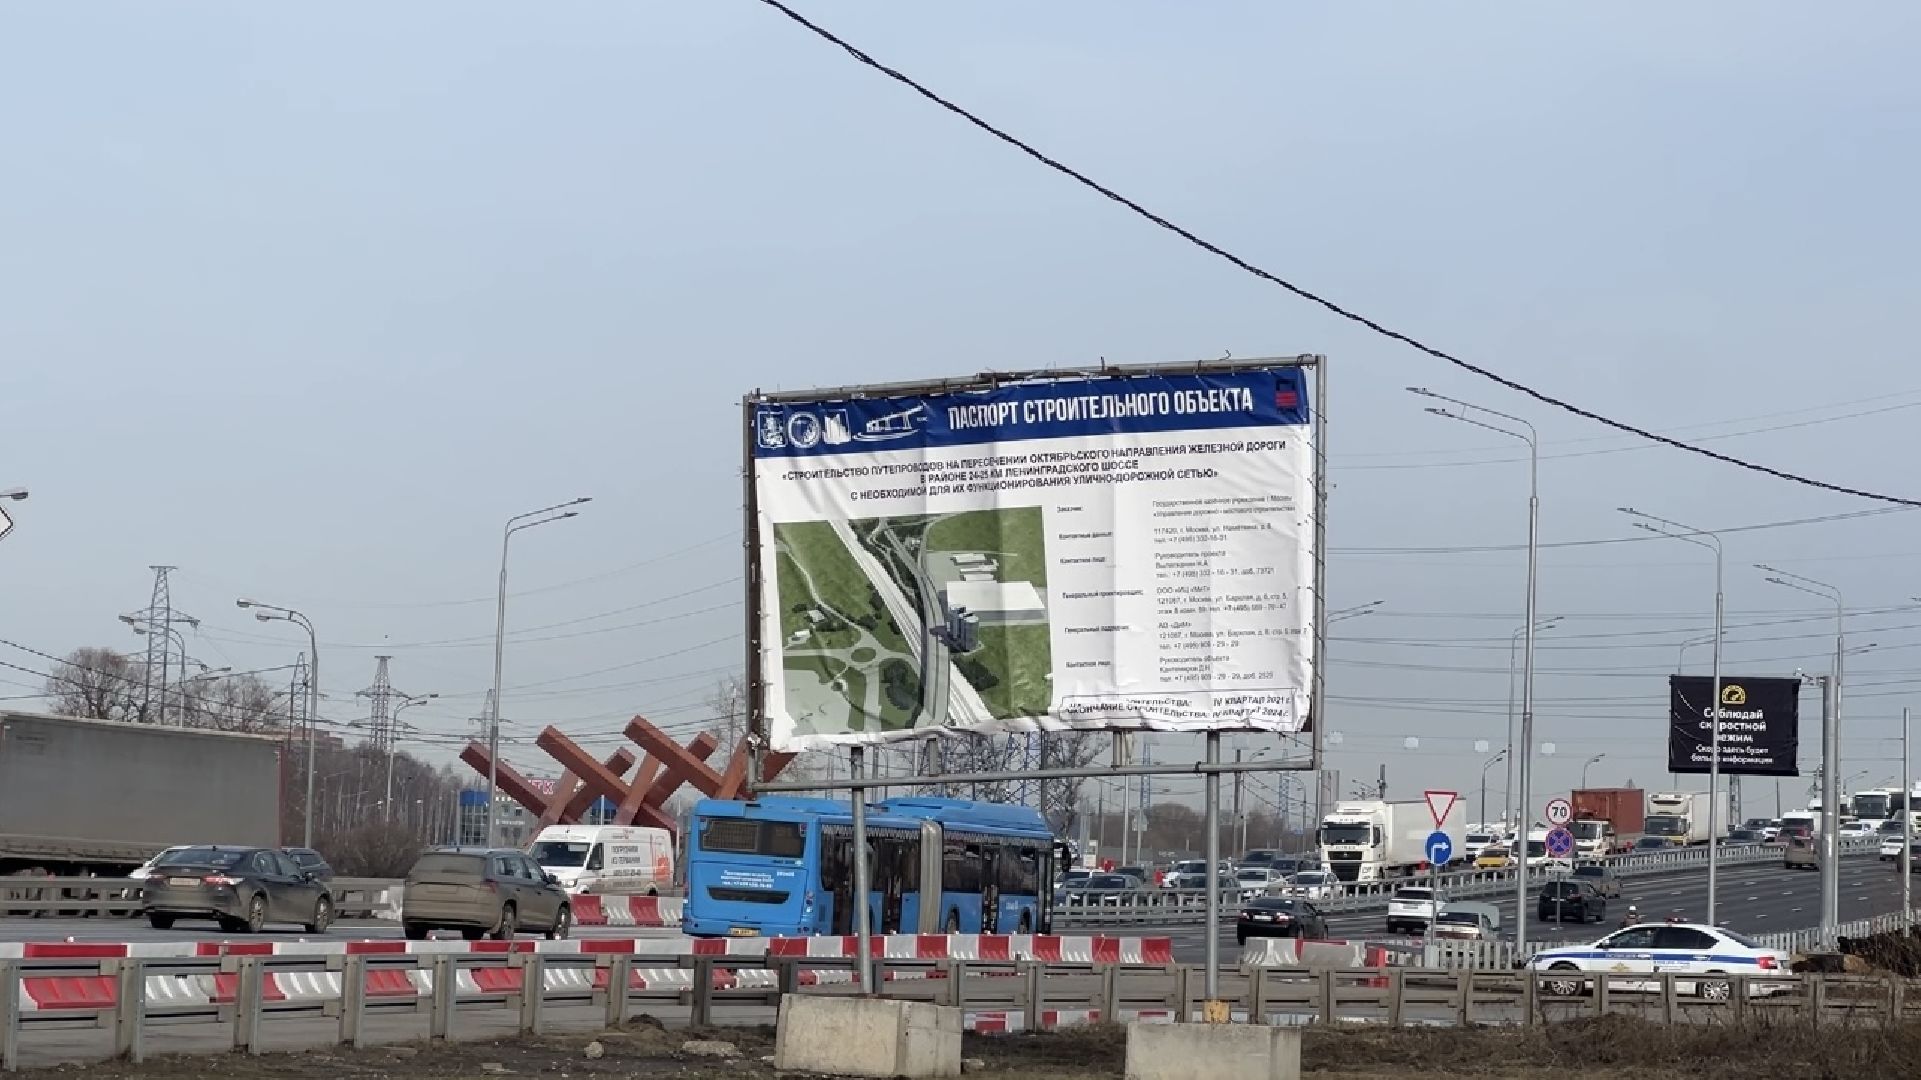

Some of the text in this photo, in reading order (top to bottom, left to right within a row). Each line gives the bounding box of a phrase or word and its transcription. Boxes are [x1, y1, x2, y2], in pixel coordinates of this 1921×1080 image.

[948, 387, 1253, 430] ПАСПОРТ СТРОИТЕЛЬНОГО ОБЪЕКТА
[783, 440, 1285, 481] «СТРОИТЕЛЬСТВО ПУТЕПРОВОДОВ НА ПЕРЕСЕЧЕНИИ ОКТЯБРЬСКОГО НАПРАВЛЕНИЯ ЖЕЛЕЗНОЙ ДОРОГИ
[920, 460, 1138, 483] В РАЙОНЕ 24-25 КМ ЛЕНИНГРАДСКОГО ШОССЕ
[851, 468, 1218, 500] С НЕОБХОДИМОЙ ДЛЯ ИХ ФУНКЦИОНИРОВАНИЯ УЛИЧНО-ДОРОЖНОЙ СЕТЬЮ»
[1700, 721, 1766, 731] скростной
[1552, 806, 1567, 818] 70
